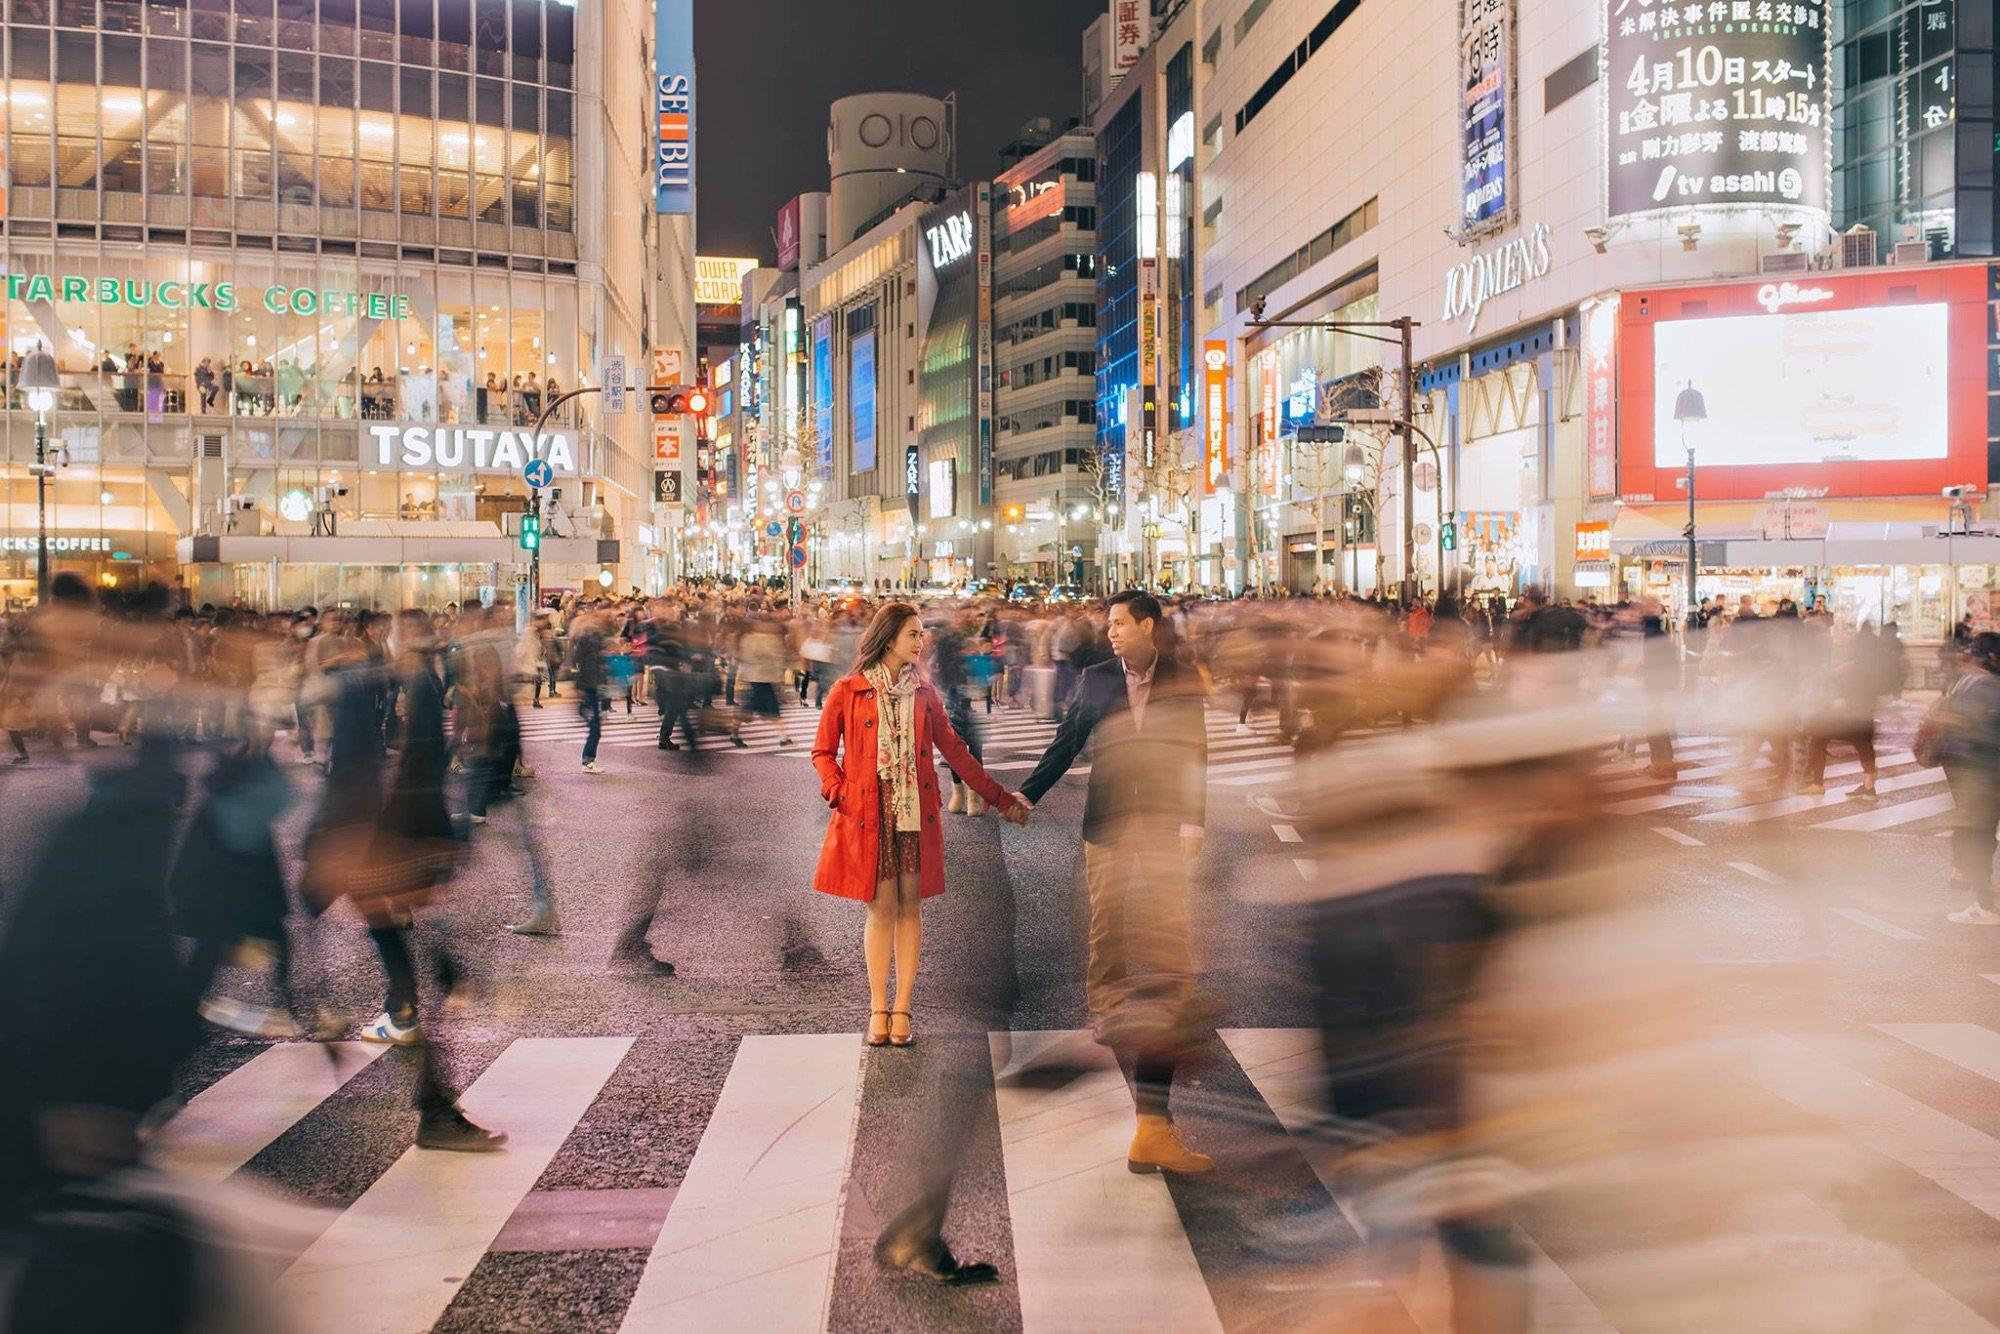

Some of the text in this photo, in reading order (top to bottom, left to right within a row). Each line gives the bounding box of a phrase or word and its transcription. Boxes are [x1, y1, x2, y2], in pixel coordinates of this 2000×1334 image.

[1119, 1, 1140, 46] 証券
[659, 74, 689, 187] SEIBU
[1677, 174, 1704, 195] tv
[1710, 170, 1775, 193] asahi
[926, 210, 973, 270] ZARA
[695, 261, 738, 280] OWER
[695, 281, 742, 300] ECORD
[264, 284, 409, 321] COFFEE
[611, 361, 622, 410] 渋谷駅前
[740, 342, 751, 407] KARAOKE
[370, 426, 574, 471] TSUTAYA
[907, 452, 918, 494] ZARA
[46, 537, 110, 551] COFFEE
